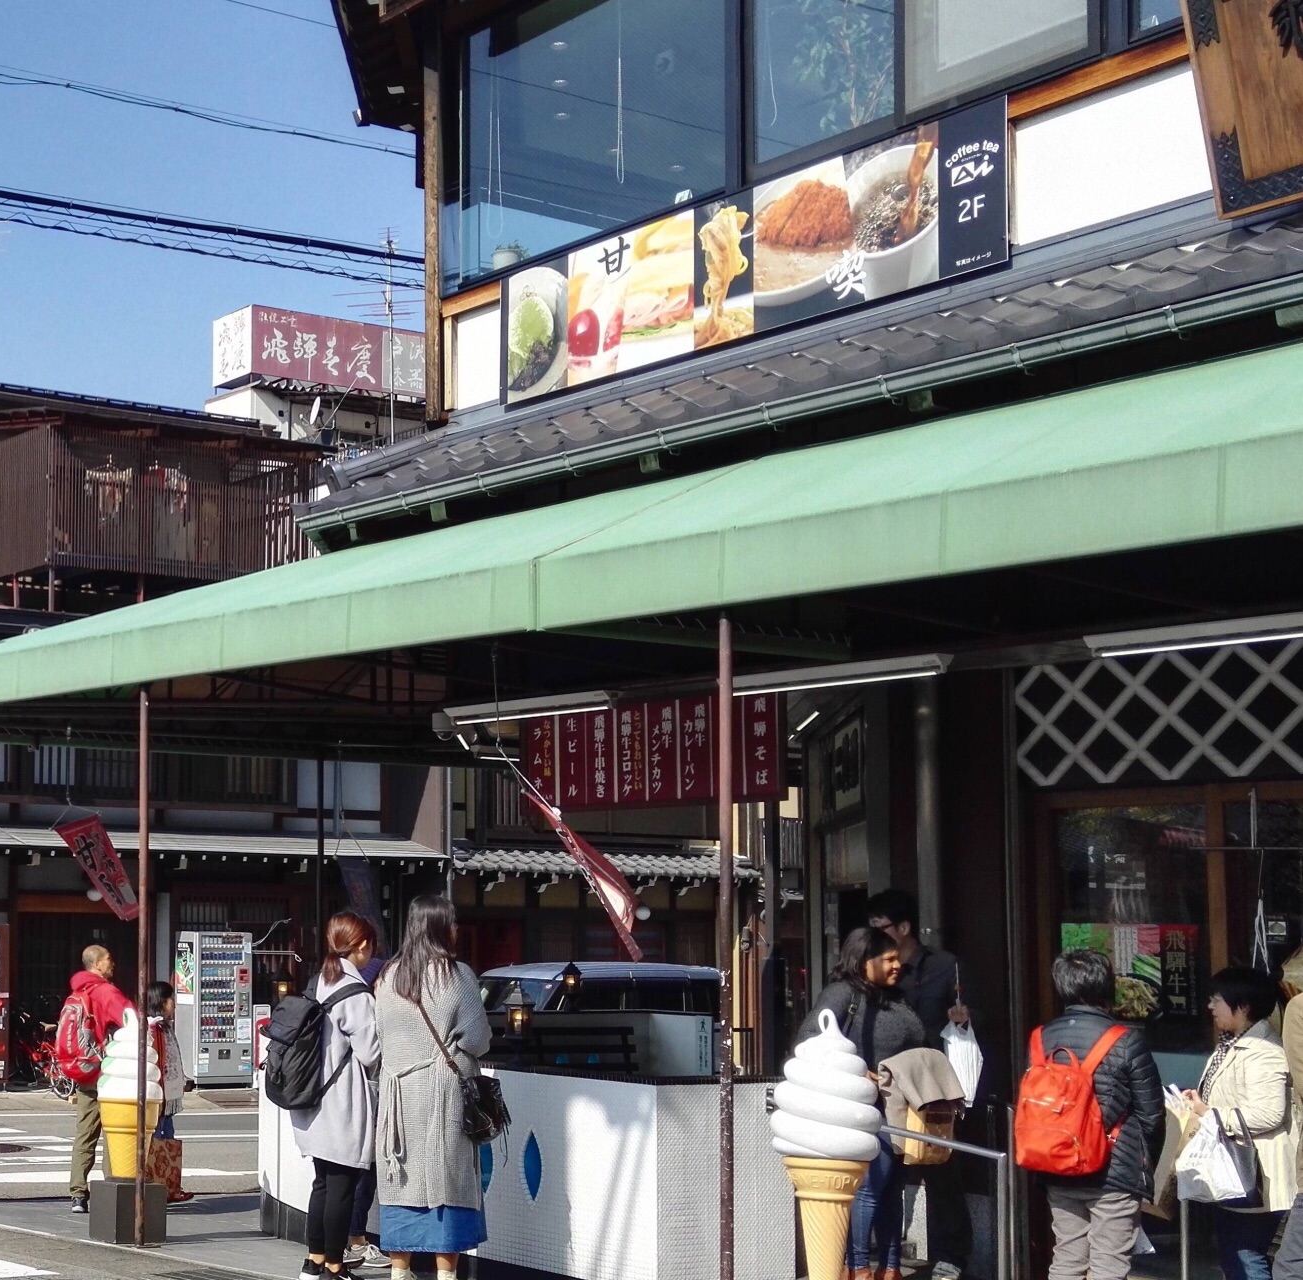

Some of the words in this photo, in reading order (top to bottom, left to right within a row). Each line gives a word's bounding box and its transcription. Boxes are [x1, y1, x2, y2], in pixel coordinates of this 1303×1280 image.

[945, 142, 980, 168] coffee
[982, 139, 1000, 153] tea
[958, 194, 986, 223] 2F
[598, 236, 631, 276] 甘
[825, 250, 868, 300] 喫
[955, 251, 992, 267] 写真はイメージ
[543, 719, 552, 777] なつかしい味
[633, 710, 644, 790] とってもおいしい
[661, 706, 673, 749] 飛騨牛
[694, 704, 706, 748] 飛騨牛
[533, 727, 544, 789] ラムネ
[566, 717, 578, 798] 生ビール
[621, 710, 633, 797] 飛騨牛コロッケ
[651, 725, 662, 794] メンチカツ
[684, 720, 695, 791] カレーパン
